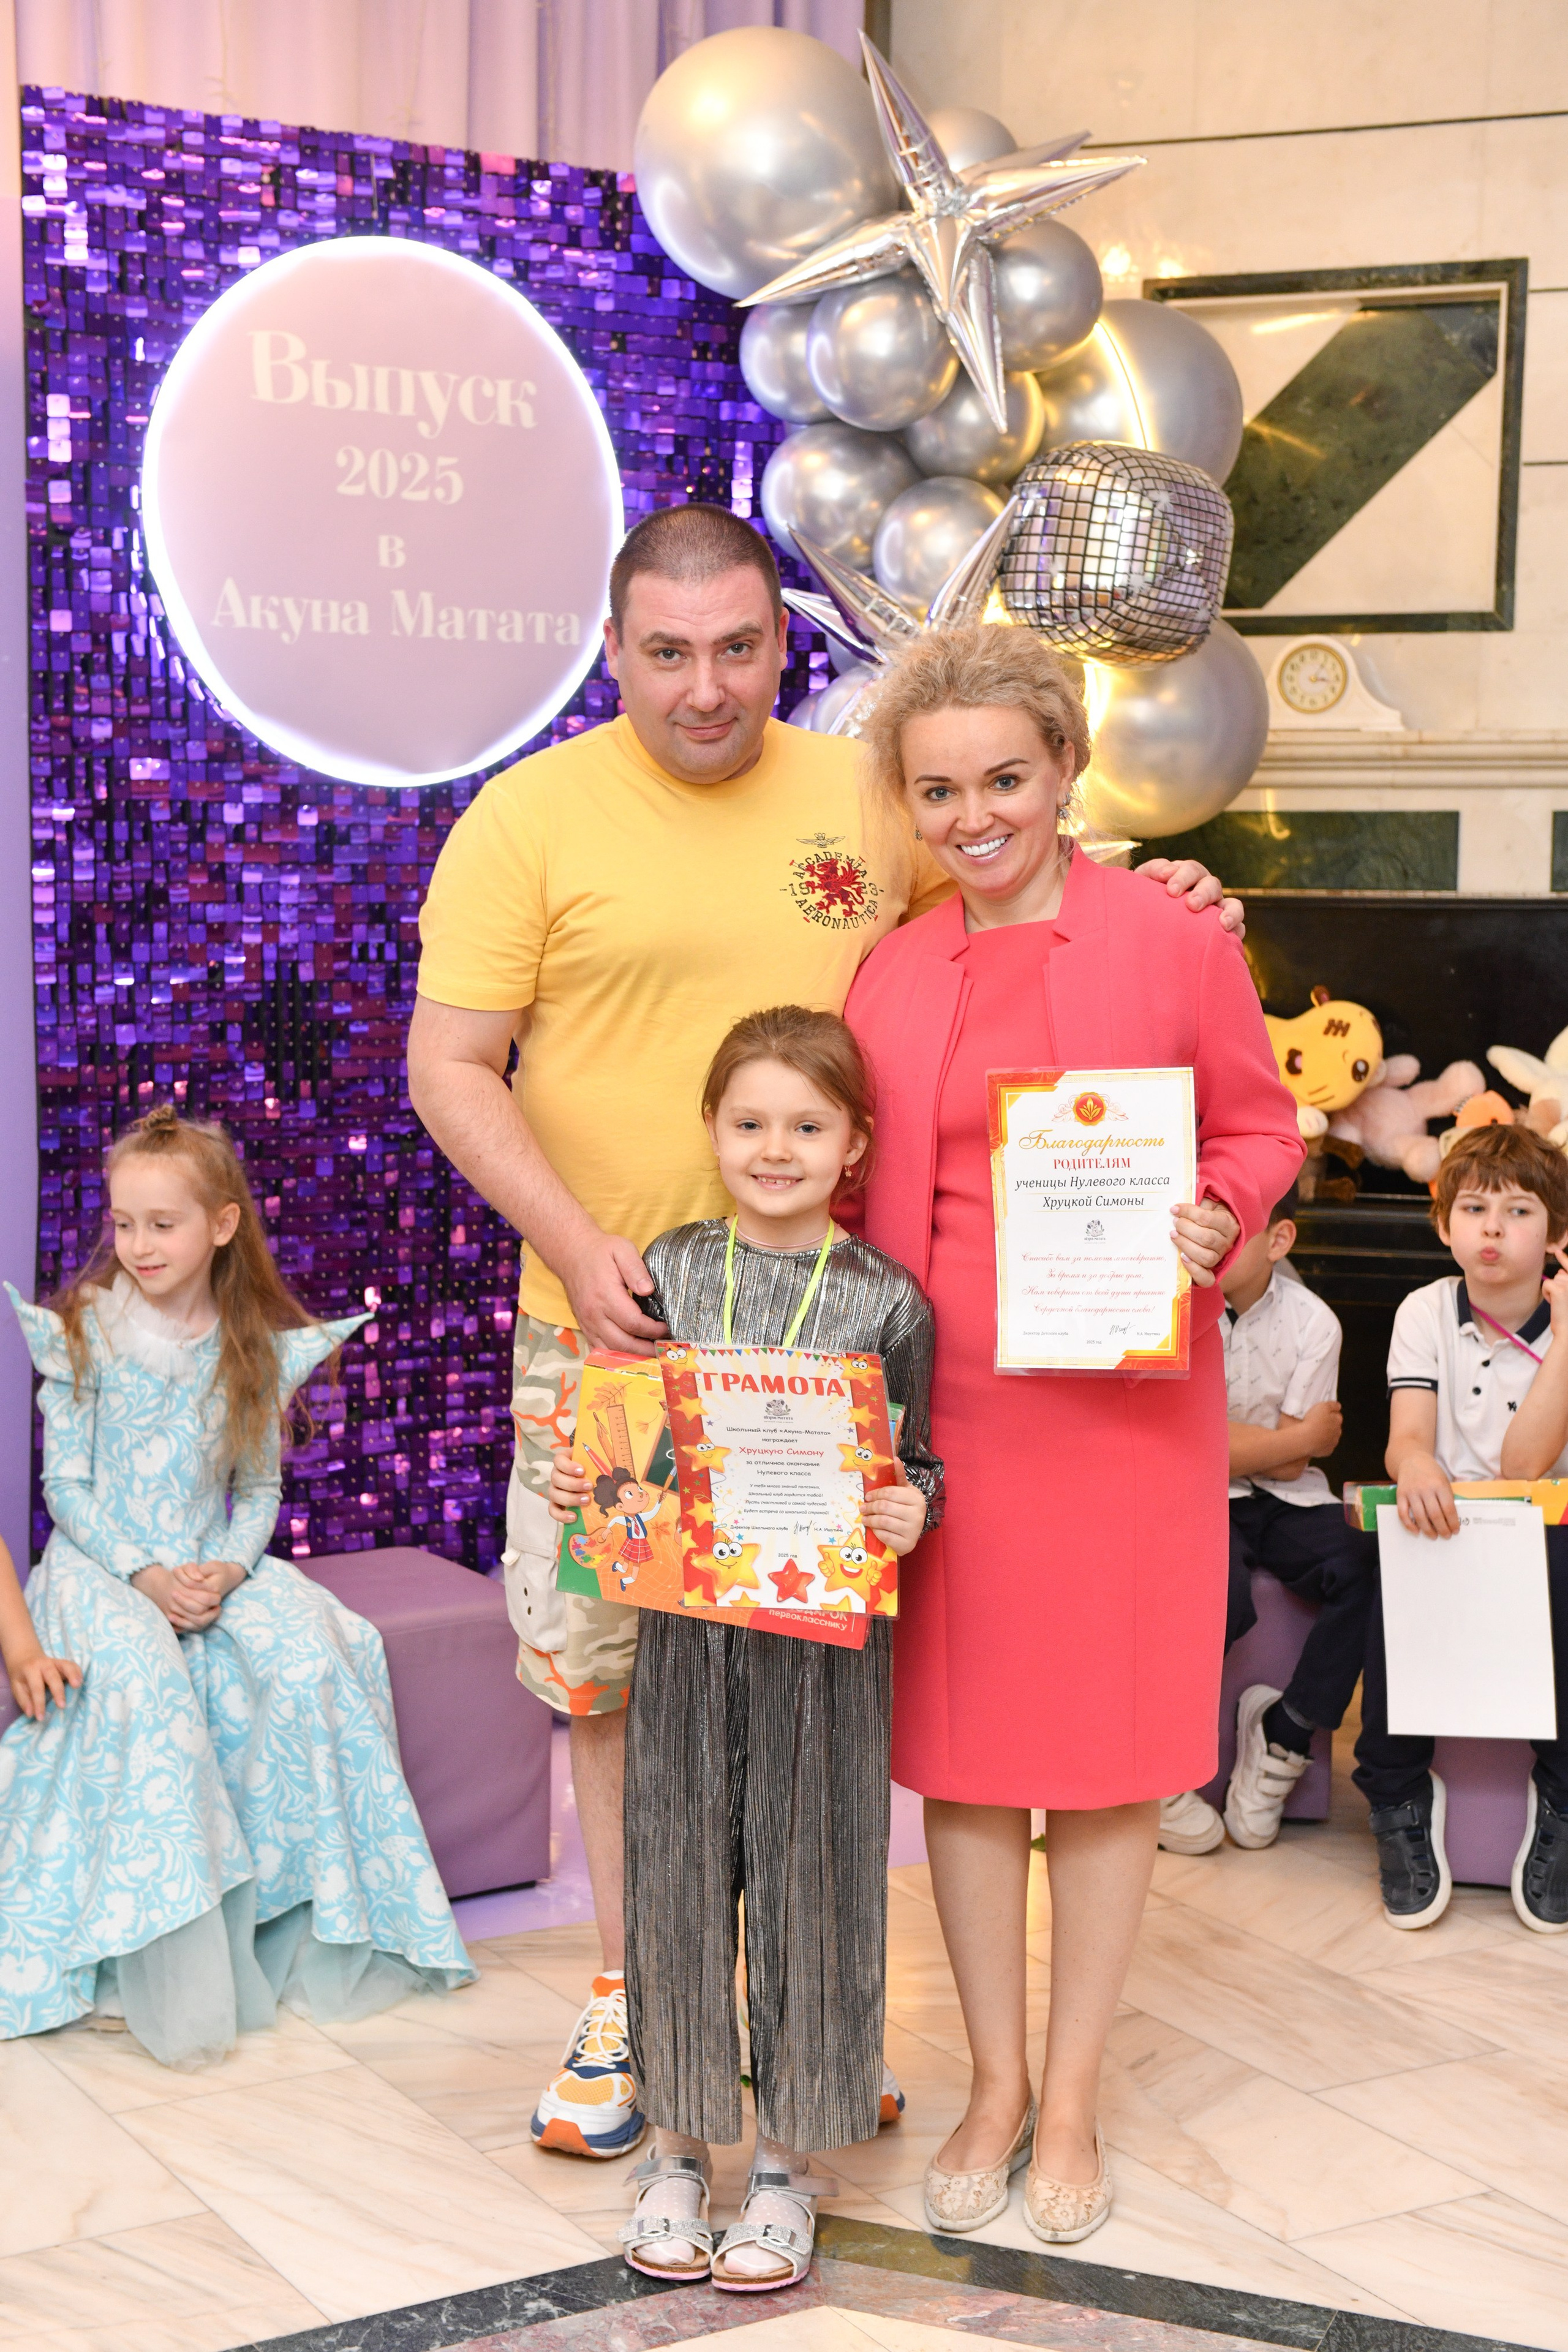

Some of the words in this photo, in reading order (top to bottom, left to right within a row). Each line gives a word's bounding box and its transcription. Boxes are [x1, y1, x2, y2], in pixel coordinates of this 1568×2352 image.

[247, 329, 537, 440] Выпуск
[335, 445, 464, 505] 2025
[378, 535, 407, 568] в
[211, 576, 369, 646] Акуна
[390, 589, 581, 646] Матата
[793, 851, 867, 879] ACCADEMIA
[795, 899, 878, 929] AERONAUTICA
[1019, 1129, 1165, 1156] Благодарность
[1054, 1158, 1131, 1171] РОДИТЕЛЯМ
[1015, 1178, 1066, 1191] ученицы
[1071, 1176, 1125, 1188] Нулевого
[1129, 1176, 1170, 1186] класса
[1043, 1196, 1092, 1210] Хруцкой
[1095, 1196, 1144, 1207] Симоны
[1022, 1252, 1054, 1261] Спасибо
[703, 1372, 846, 1397] ГРАМОТА
[739, 1446, 783, 1456] Хруцкую
[786, 1448, 824, 1458] Симону
[769, 1609, 848, 1631] первокласснику
